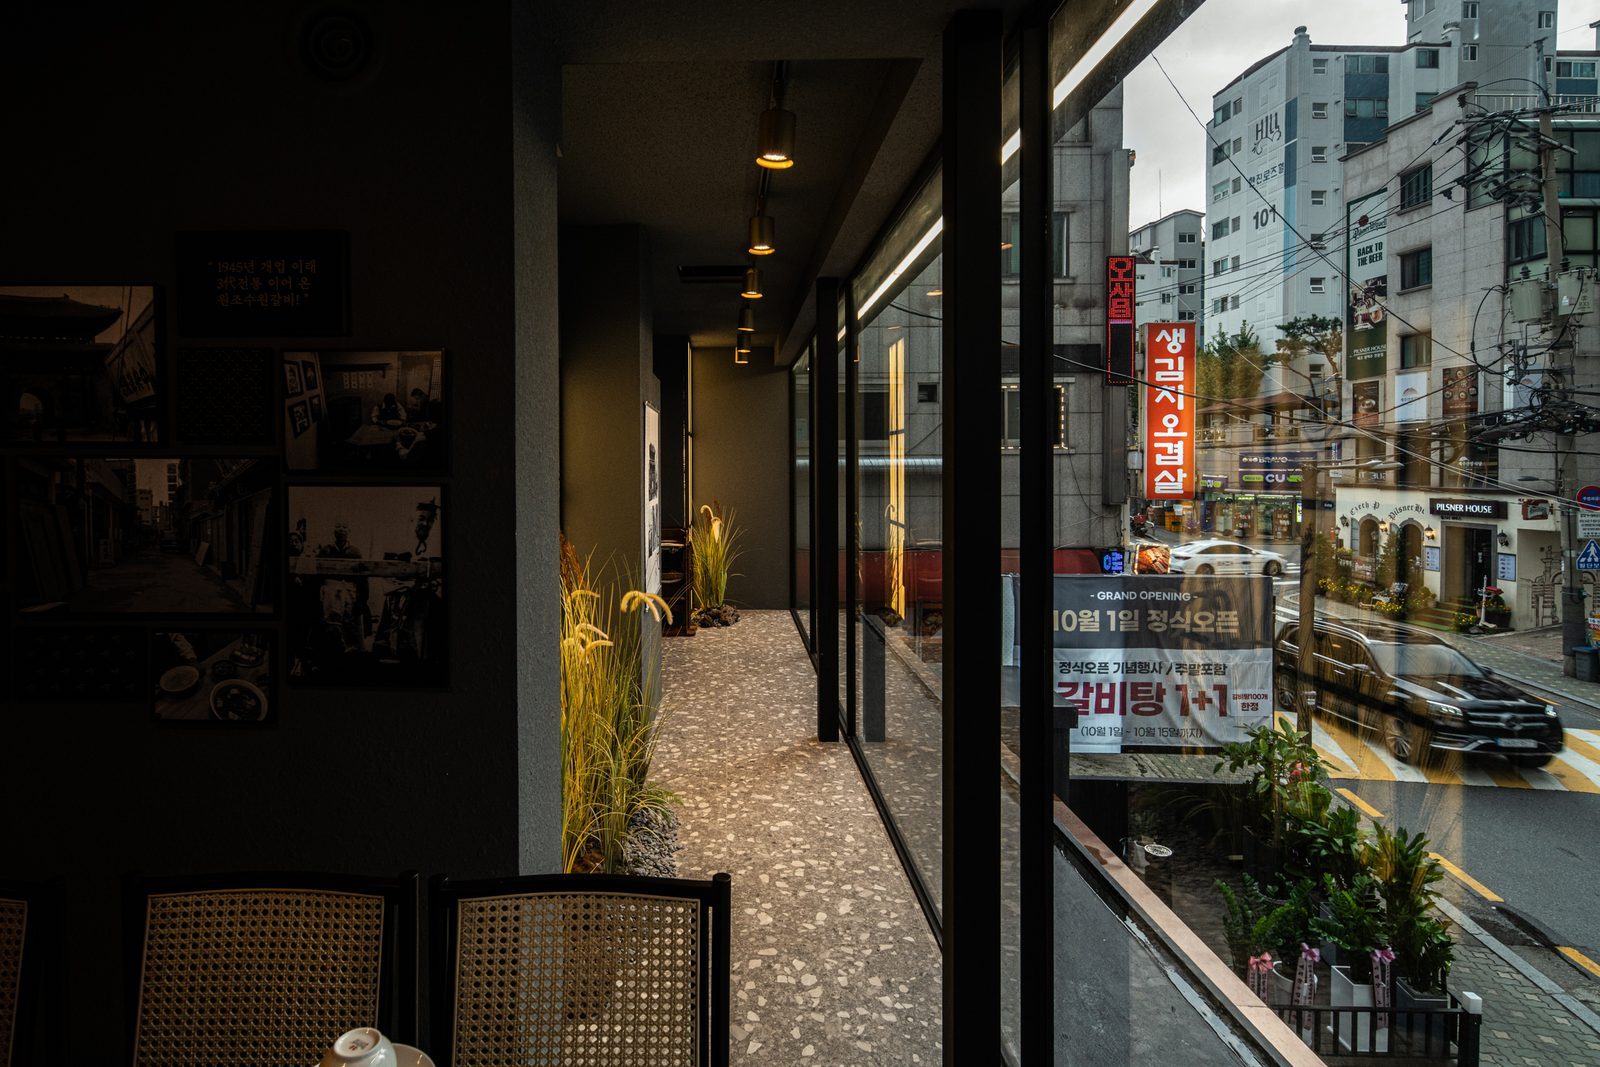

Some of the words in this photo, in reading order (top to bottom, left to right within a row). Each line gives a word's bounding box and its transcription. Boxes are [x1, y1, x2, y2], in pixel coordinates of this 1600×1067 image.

[1253, 204, 1276, 230] 101
[1357, 245, 1373, 257] BACK
[1375, 242, 1383, 251] TO
[1358, 256, 1367, 267] THE
[1369, 252, 1383, 264] BEER
[1154, 328, 1188, 494] 생김치오겹살
[1265, 474, 1285, 483] CU
[1388, 505, 1413, 520] Pilsner
[1436, 503, 1464, 512] PILSNER
[1465, 504, 1492, 513] HOUSE
[1097, 591, 1136, 600] GRAND
[1139, 591, 1191, 601] OPENING
[1053, 610, 1099, 632] 10월
[1107, 610, 1139, 632] 1일
[1147, 610, 1239, 633] 정식오픈
[1059, 661, 1110, 675] 정식오픈
[1113, 661, 1163, 675] 기념행사
[1175, 663, 1228, 676] 주말포함
[1057, 682, 1166, 717] 갈비탕
[1176, 684, 1228, 717] 1+1
[1241, 702, 1259, 711] 한정
